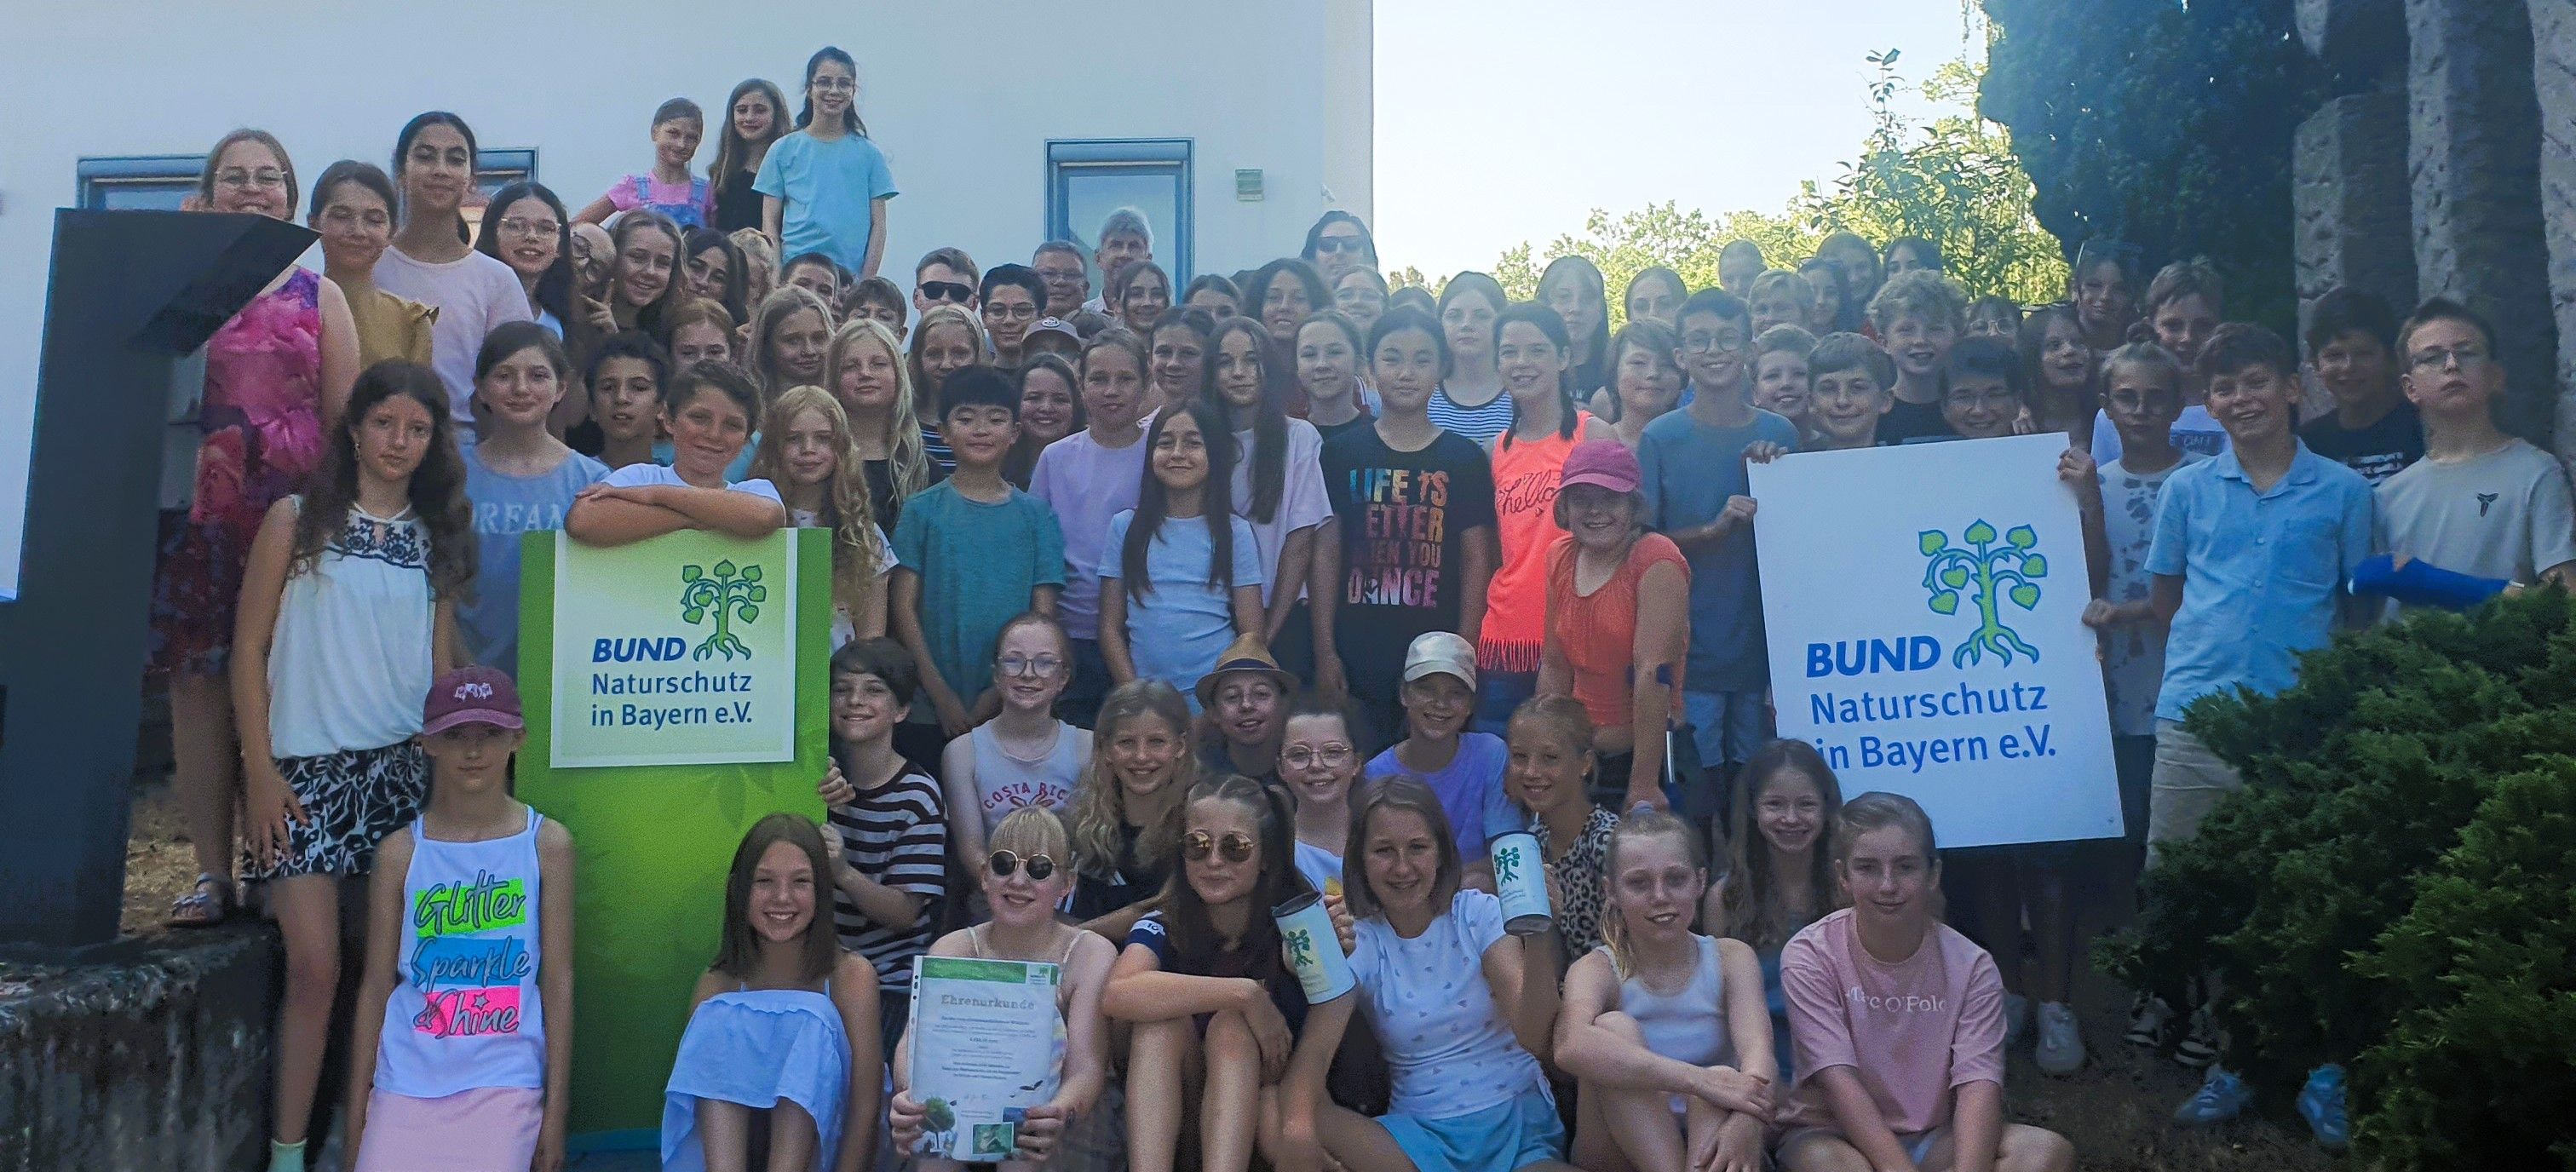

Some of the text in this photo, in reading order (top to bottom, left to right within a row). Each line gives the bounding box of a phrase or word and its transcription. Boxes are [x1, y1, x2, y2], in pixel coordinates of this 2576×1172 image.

[1348, 467, 1449, 507] LIFE IS
[1501, 468, 1559, 516] hello
[471, 501, 563, 534] REA
[1365, 501, 1445, 543] ETTER
[1408, 541, 1441, 568] YOU
[1348, 566, 1440, 608] DANCE
[592, 637, 687, 663] BUND
[1806, 635, 1941, 678] BUND
[592, 670, 752, 695] Naturschutz
[1810, 681, 2048, 725] Naturschutz
[591, 701, 752, 731] in Bayern e.V.
[1860, 735, 1989, 774] Bayern
[1999, 724, 2057, 759] e.V.
[984, 782, 1067, 809] COSTA RIC
[413, 869, 527, 935] Glitter
[410, 935, 532, 993] Sparkle
[940, 994, 1035, 1010] Ehrenurkunde
